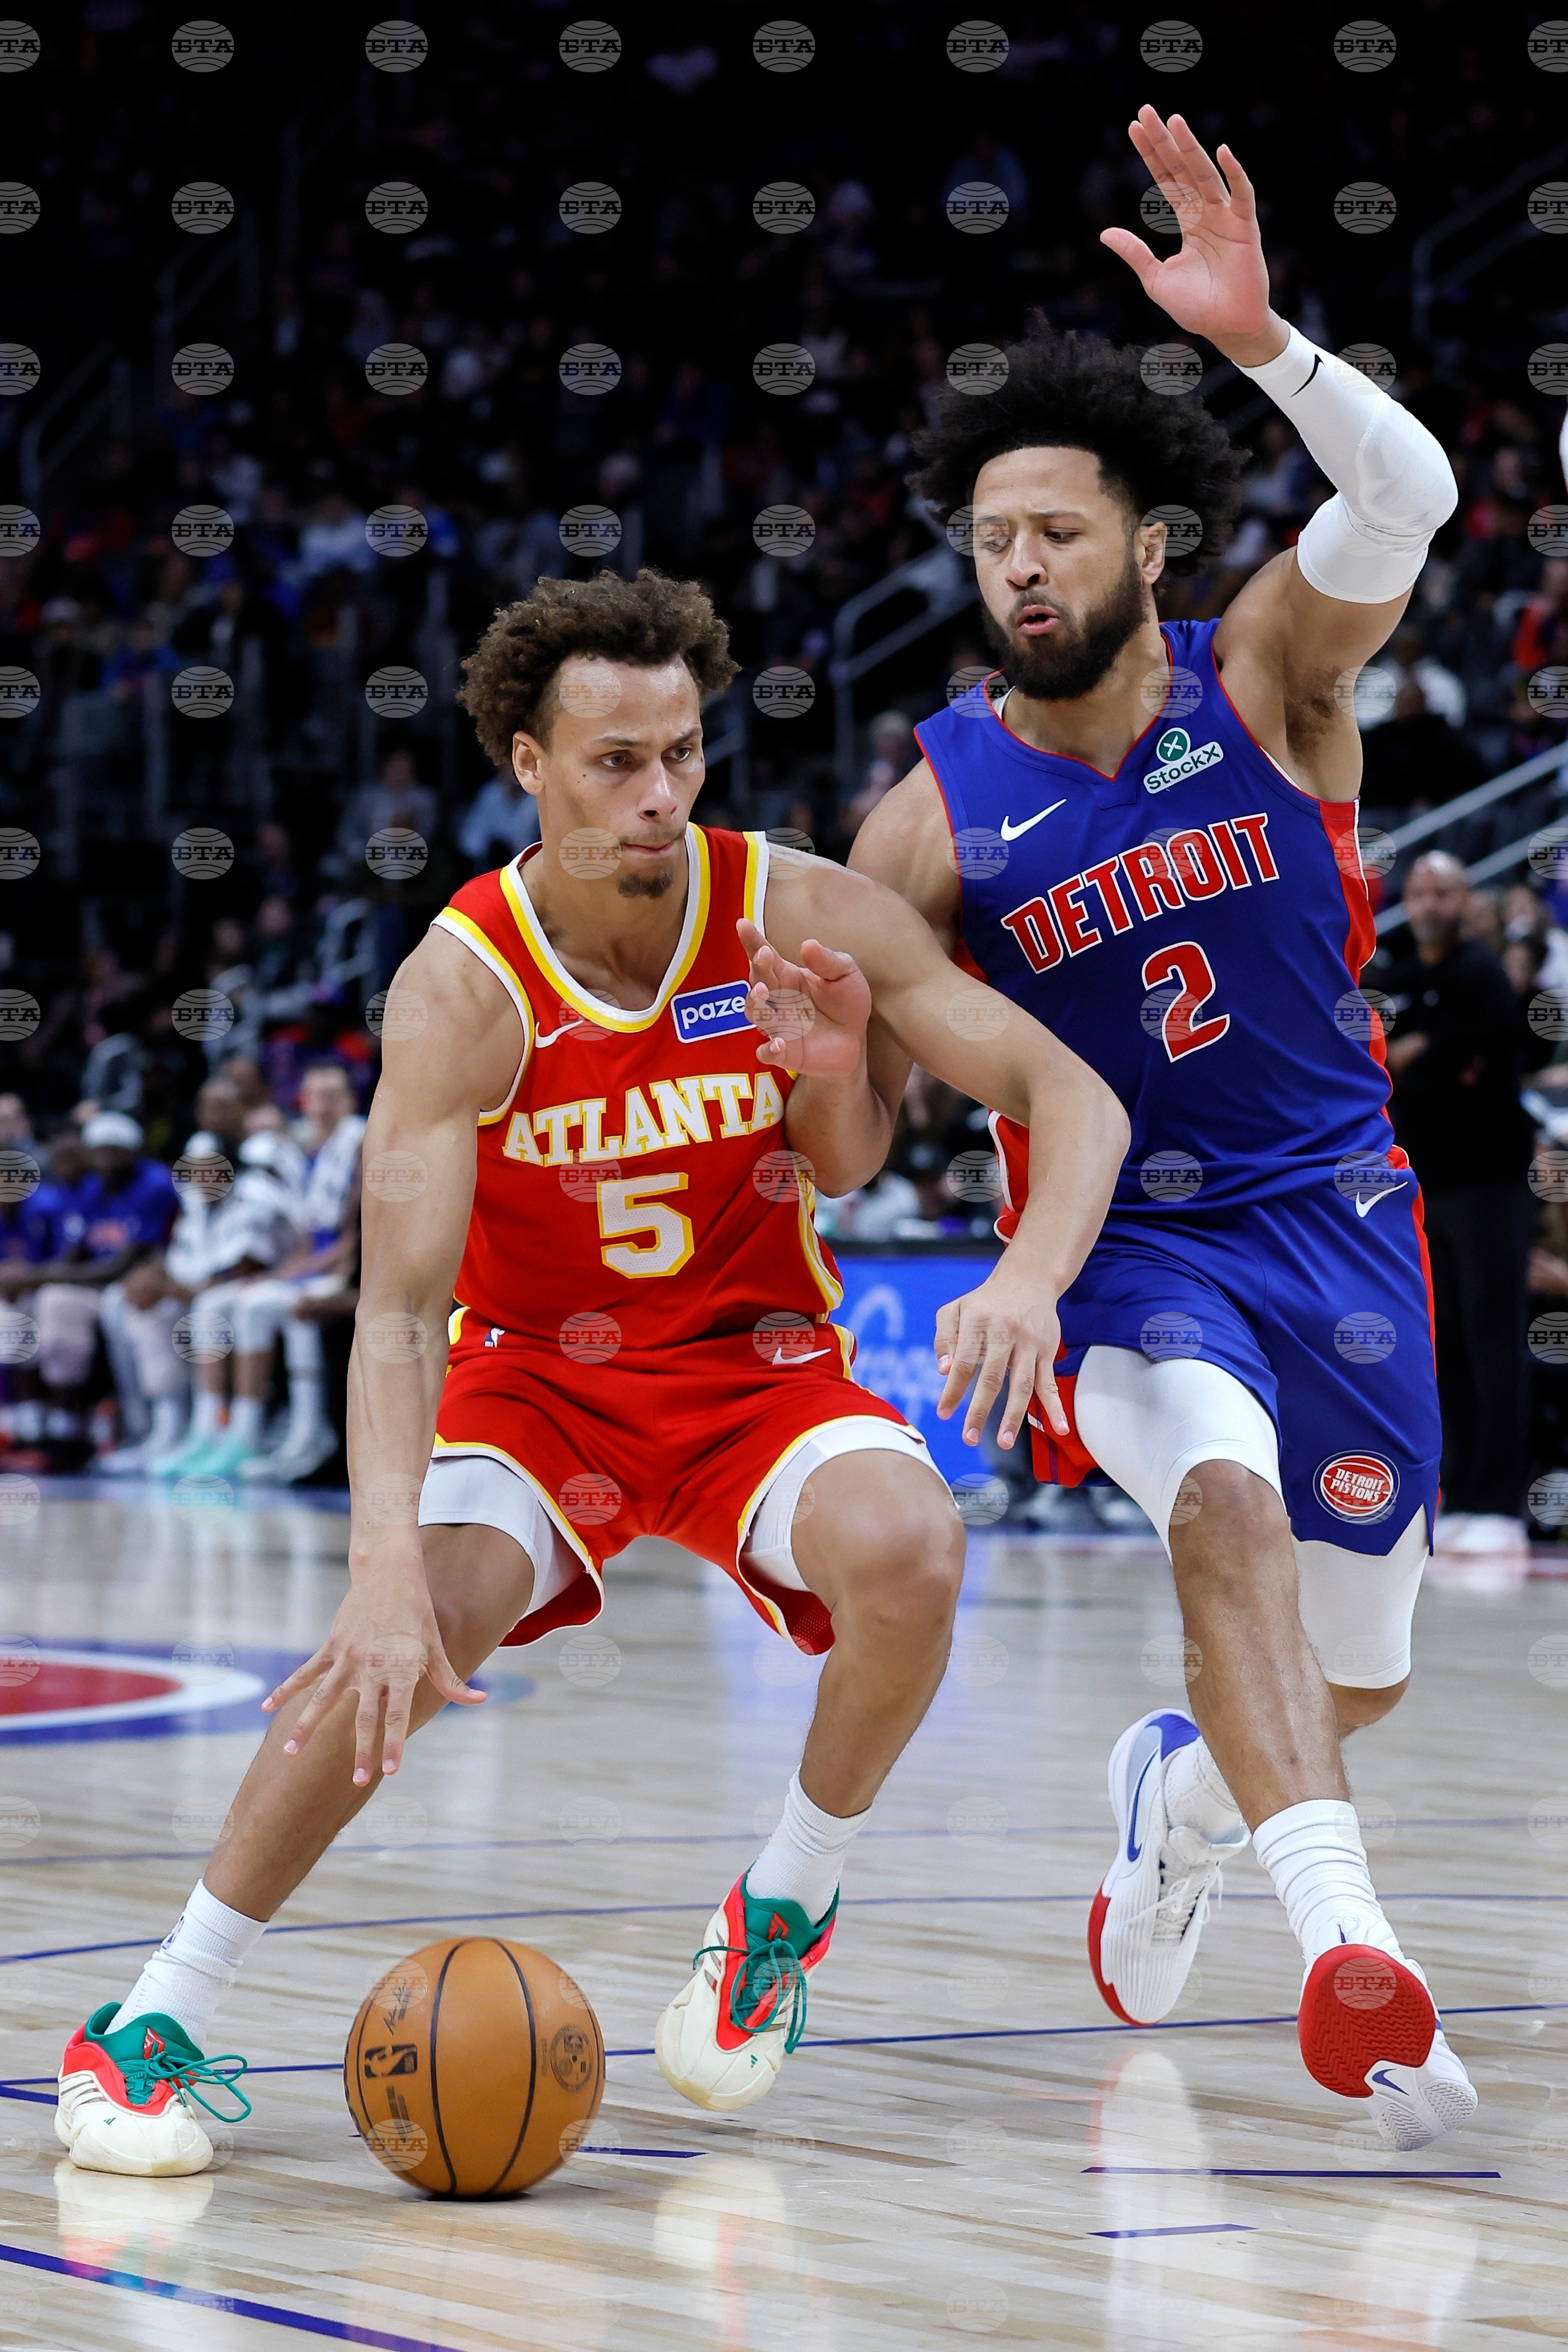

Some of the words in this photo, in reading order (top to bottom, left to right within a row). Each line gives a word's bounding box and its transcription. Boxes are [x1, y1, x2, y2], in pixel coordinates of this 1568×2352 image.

[1147, 744, 1220, 790] StockX
[1000, 813, 1280, 974] DETROIT
[681, 996, 746, 1030] paze
[1142, 941, 1230, 1063] 2
[502, 1071, 784, 1167] ATLANTA
[597, 1172, 695, 1279] 5
[1330, 1478, 1381, 1502] PISTONS
[1335, 1468, 1385, 1491] DETROIT
